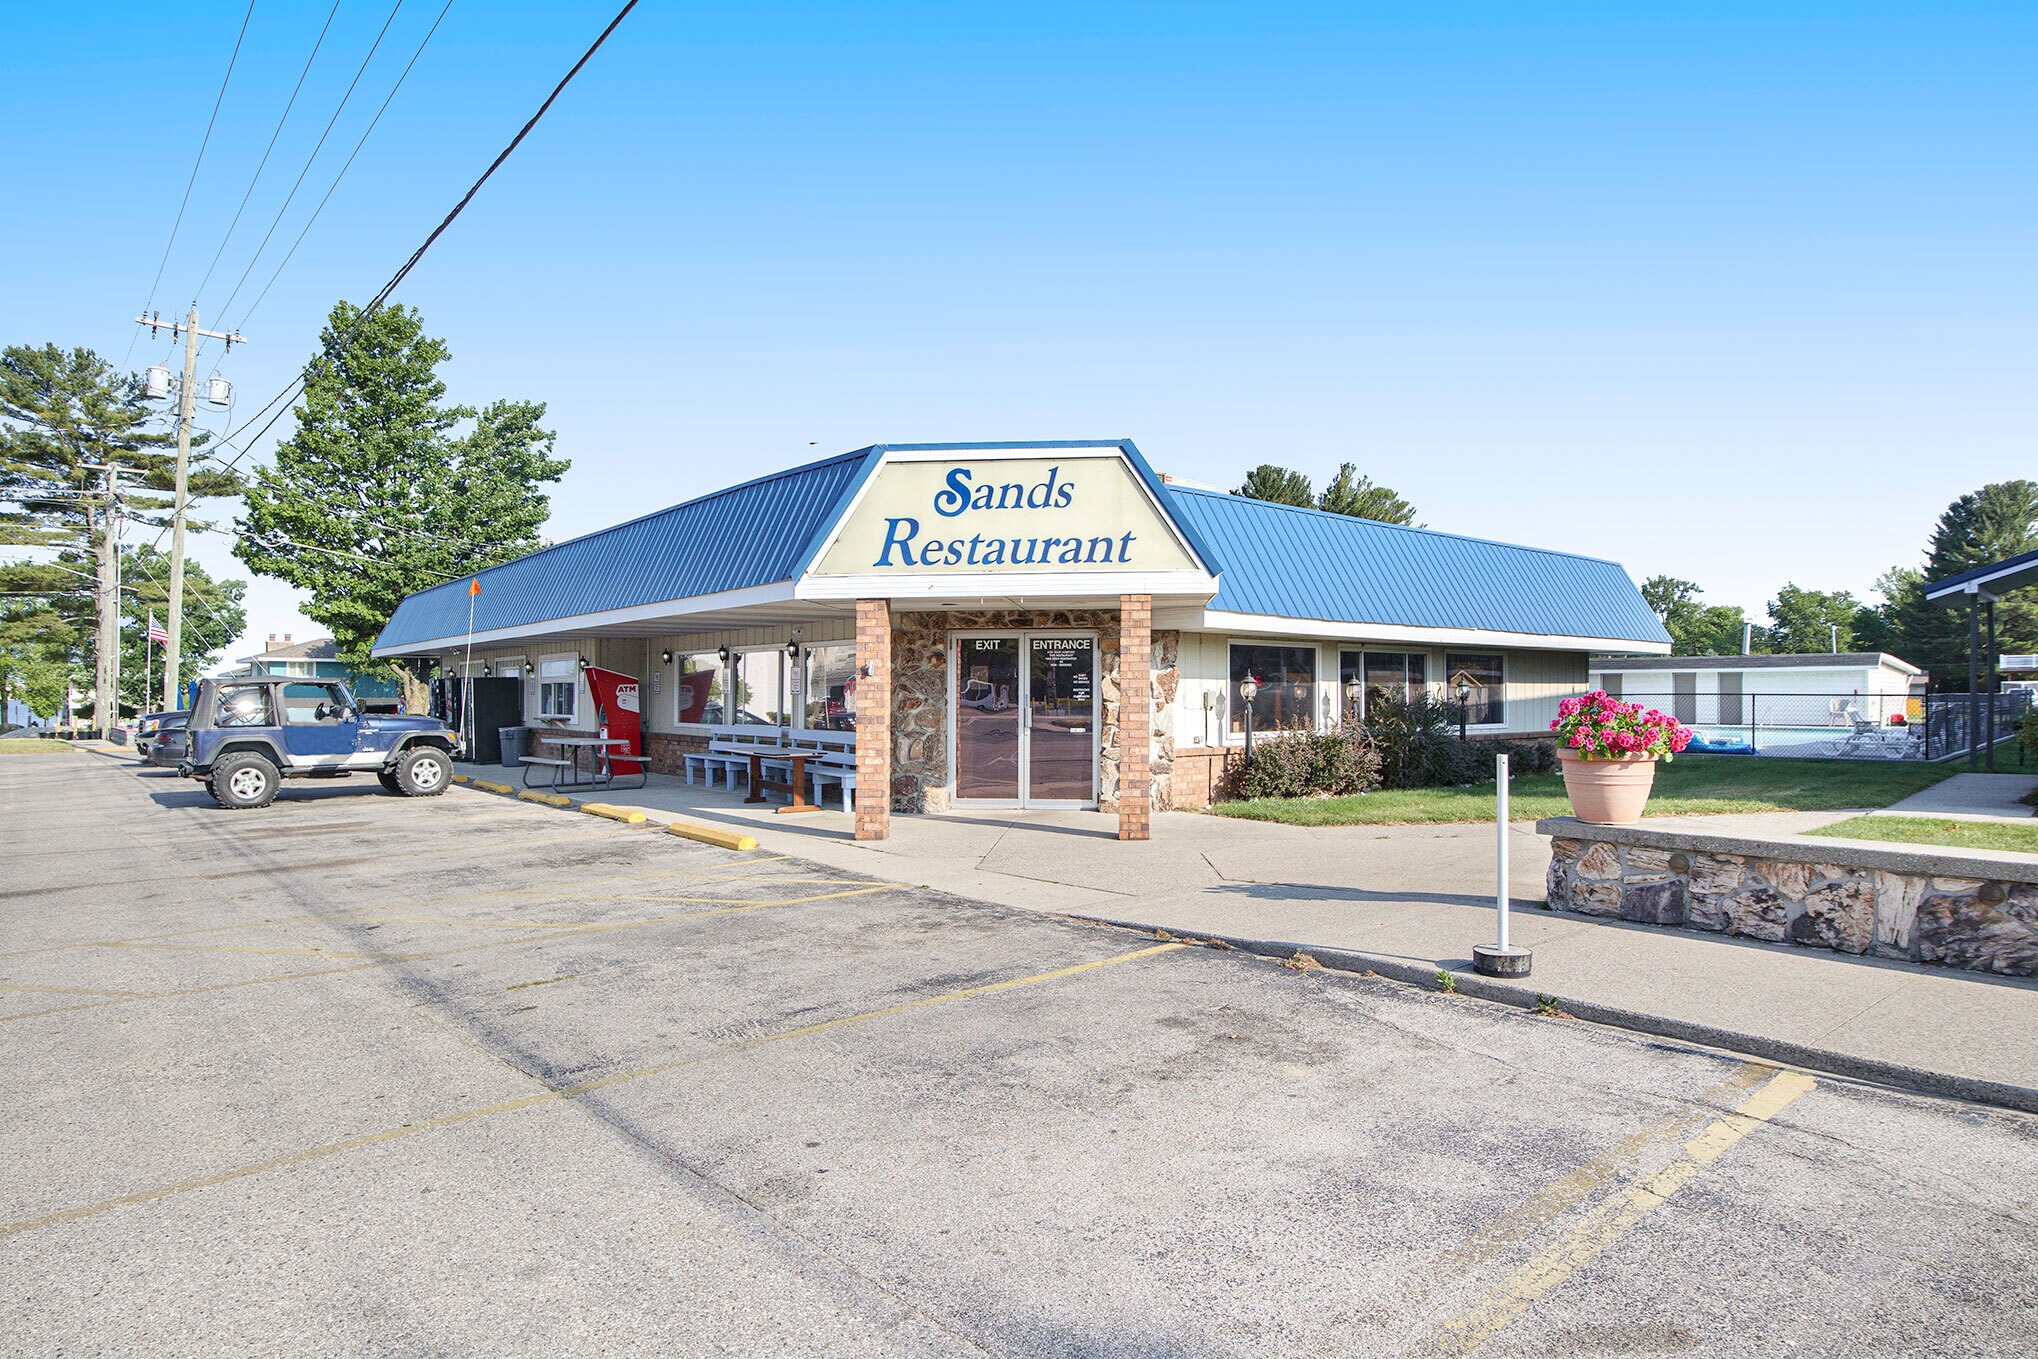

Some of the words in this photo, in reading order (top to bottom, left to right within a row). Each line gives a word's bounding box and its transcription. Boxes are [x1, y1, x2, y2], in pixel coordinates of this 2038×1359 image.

[933, 466, 1075, 518] Sands
[873, 517, 1137, 567] Restaurant
[975, 640, 1001, 650] EXIT
[1033, 639, 1091, 650] ENTRANCE
[617, 685, 637, 693] ATM
